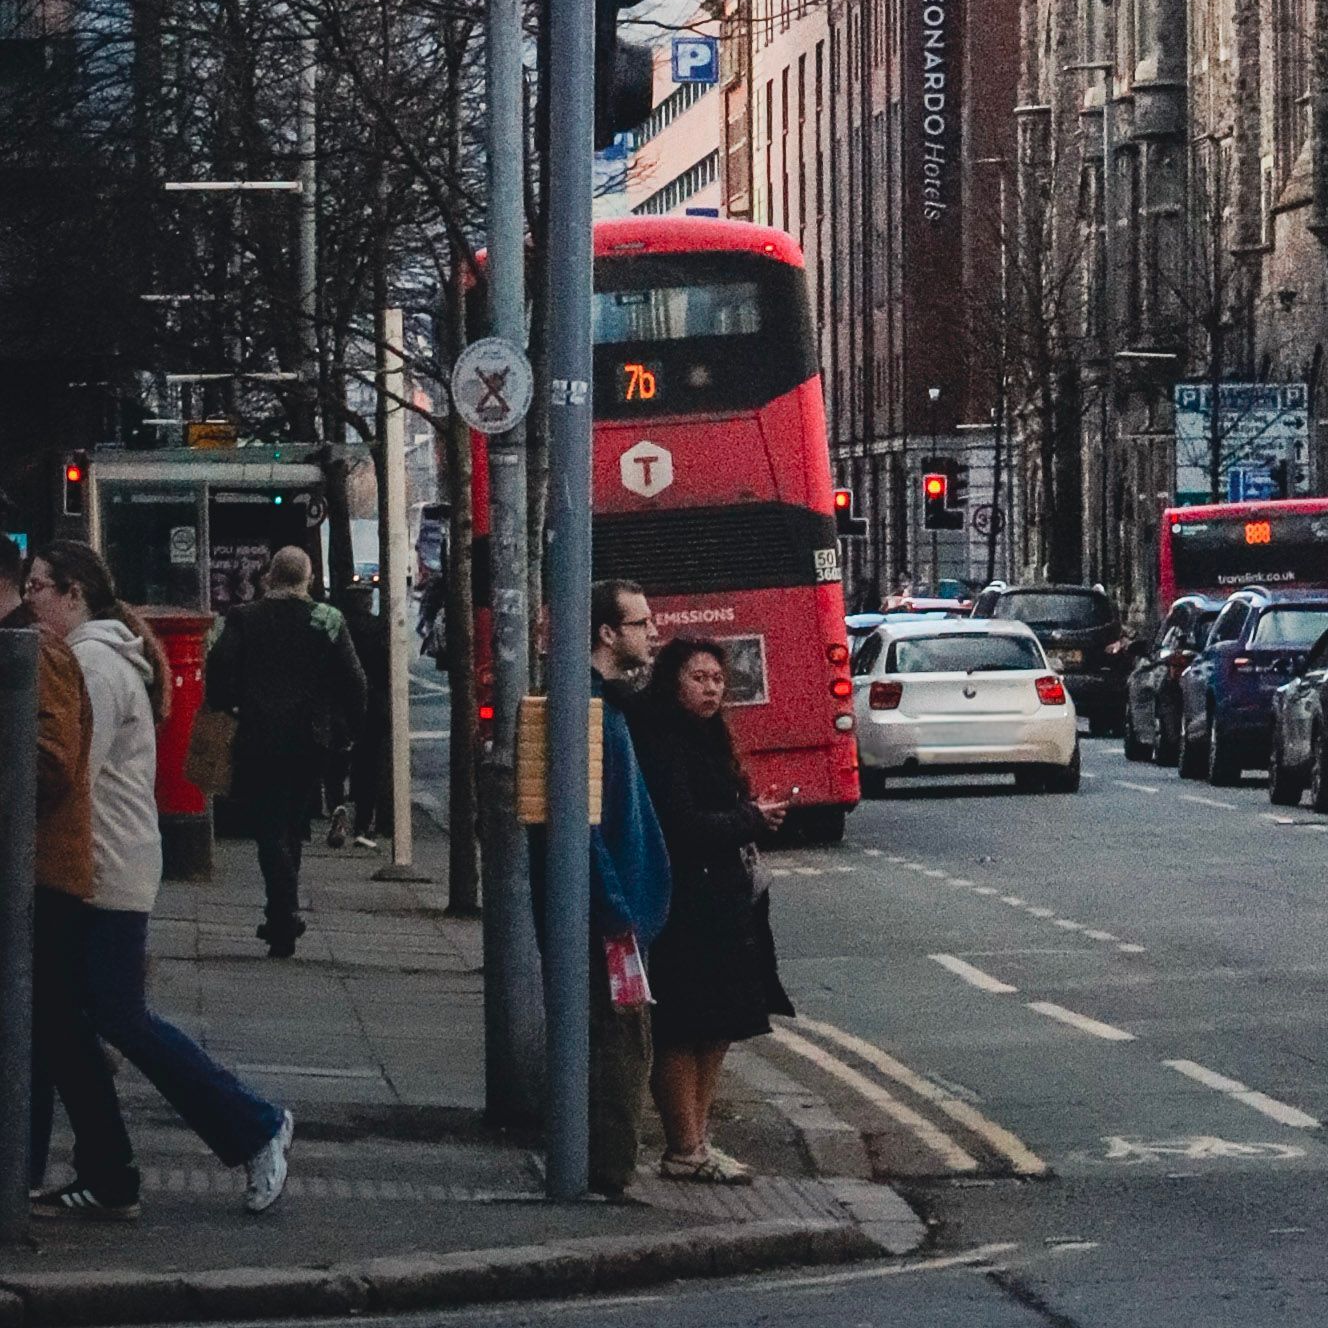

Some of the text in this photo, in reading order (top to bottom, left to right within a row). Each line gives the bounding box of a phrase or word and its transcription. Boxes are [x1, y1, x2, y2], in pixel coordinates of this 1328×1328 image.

[923, 142, 947, 221] Hotels
[624, 363, 656, 400] 7b
[633, 456, 659, 487] T
[817, 550, 834, 566] 50
[1217, 570, 1296, 585] translink.co.uk
[655, 607, 736, 626] EMISSIONS
